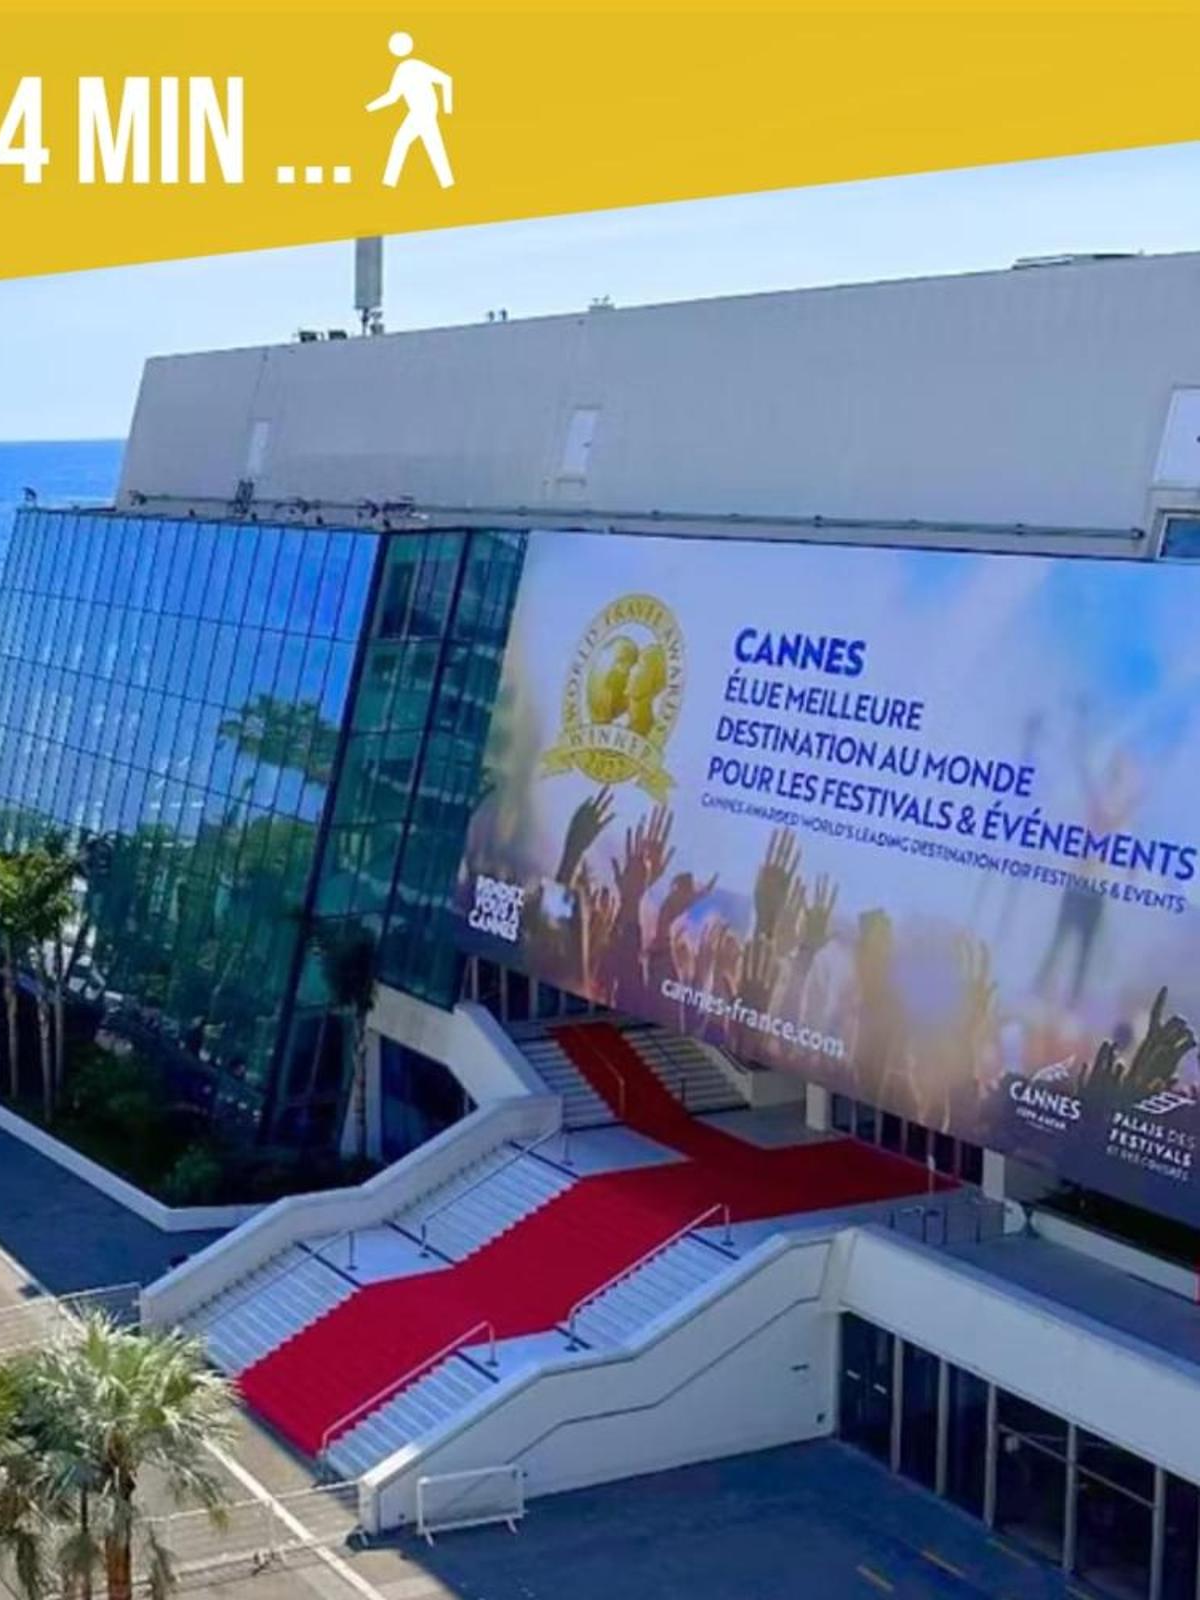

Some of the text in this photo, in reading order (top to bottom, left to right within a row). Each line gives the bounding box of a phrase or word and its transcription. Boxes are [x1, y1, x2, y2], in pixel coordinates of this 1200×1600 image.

[733, 627, 867, 677] CANNES
[724, 667, 925, 731] ÉLUE MEILLEURE
[715, 716, 1036, 797] DESTINATION AU MONDE
[706, 756, 1199, 881] POUR LES FESTIVALS & ÉVÉNEMENTS
[909, 839, 1000, 872] DESTINATION
[1000, 857, 1032, 878] FOR
[1032, 865, 1108, 898] FESTIVALS
[1121, 883, 1188, 914] EVENTS
[1009, 1080, 1081, 1120] CANNES
[1112, 1112, 1164, 1138] PALAIS
[1109, 1127, 1192, 1168] FESTIVALS
